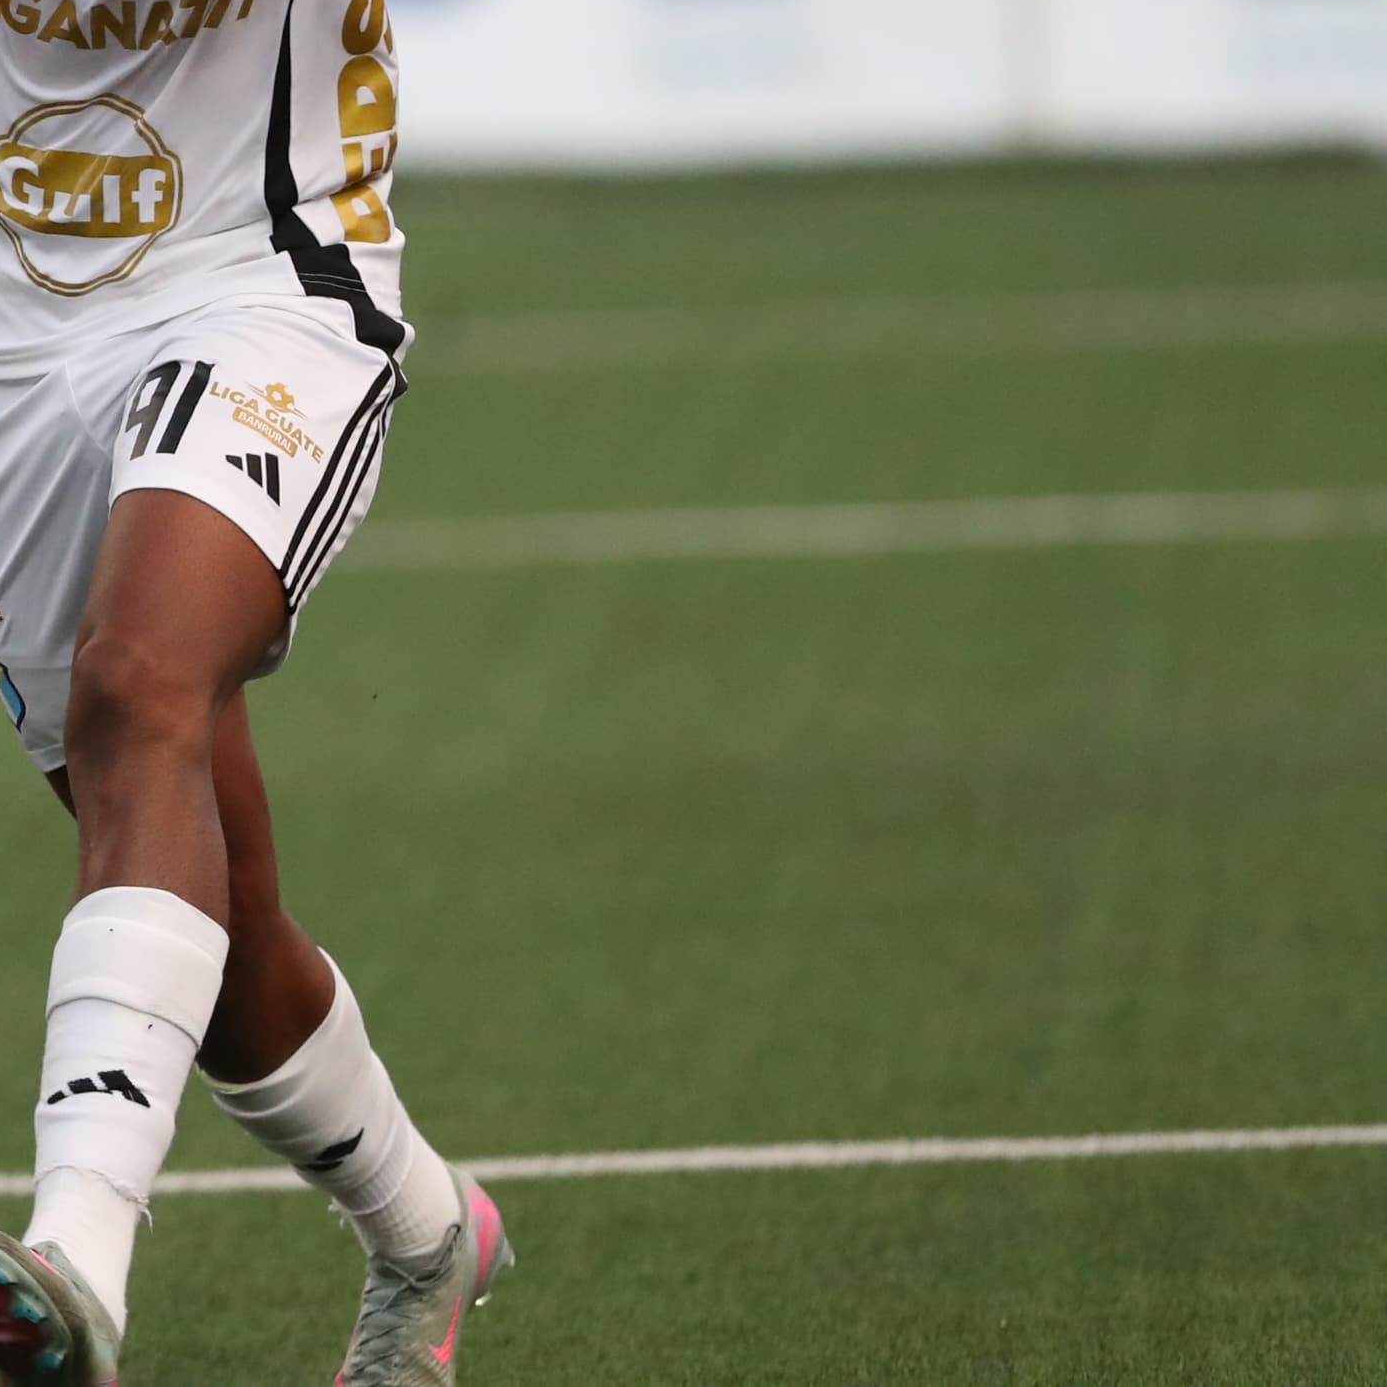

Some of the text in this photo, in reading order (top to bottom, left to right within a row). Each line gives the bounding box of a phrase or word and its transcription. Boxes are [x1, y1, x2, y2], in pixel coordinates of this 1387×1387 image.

[124, 359, 216, 462] 91
[209, 381, 324, 465] LIGA GUATE
[238, 410, 294, 452] BANRURAL
